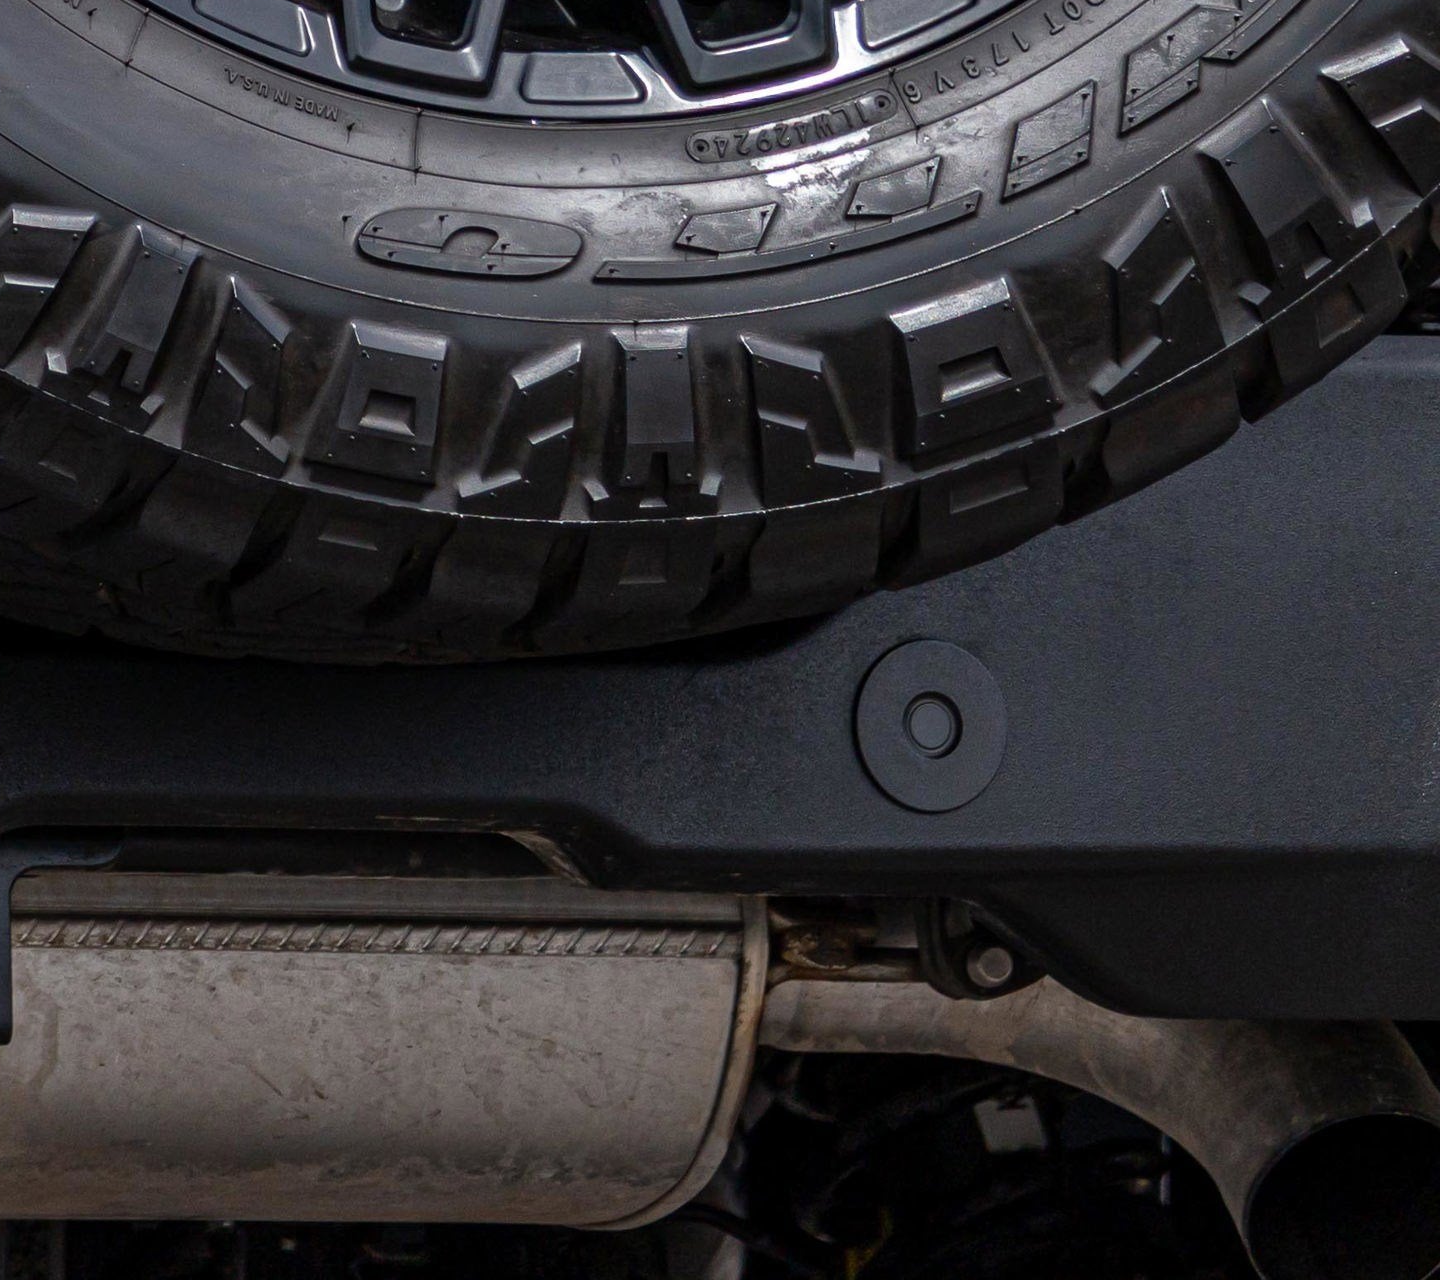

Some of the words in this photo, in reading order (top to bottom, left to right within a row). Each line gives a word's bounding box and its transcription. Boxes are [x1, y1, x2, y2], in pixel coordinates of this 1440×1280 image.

[223, 67, 269, 99] U.S.A.
[272, 93, 290, 107] IN
[293, 96, 338, 123] MADE
